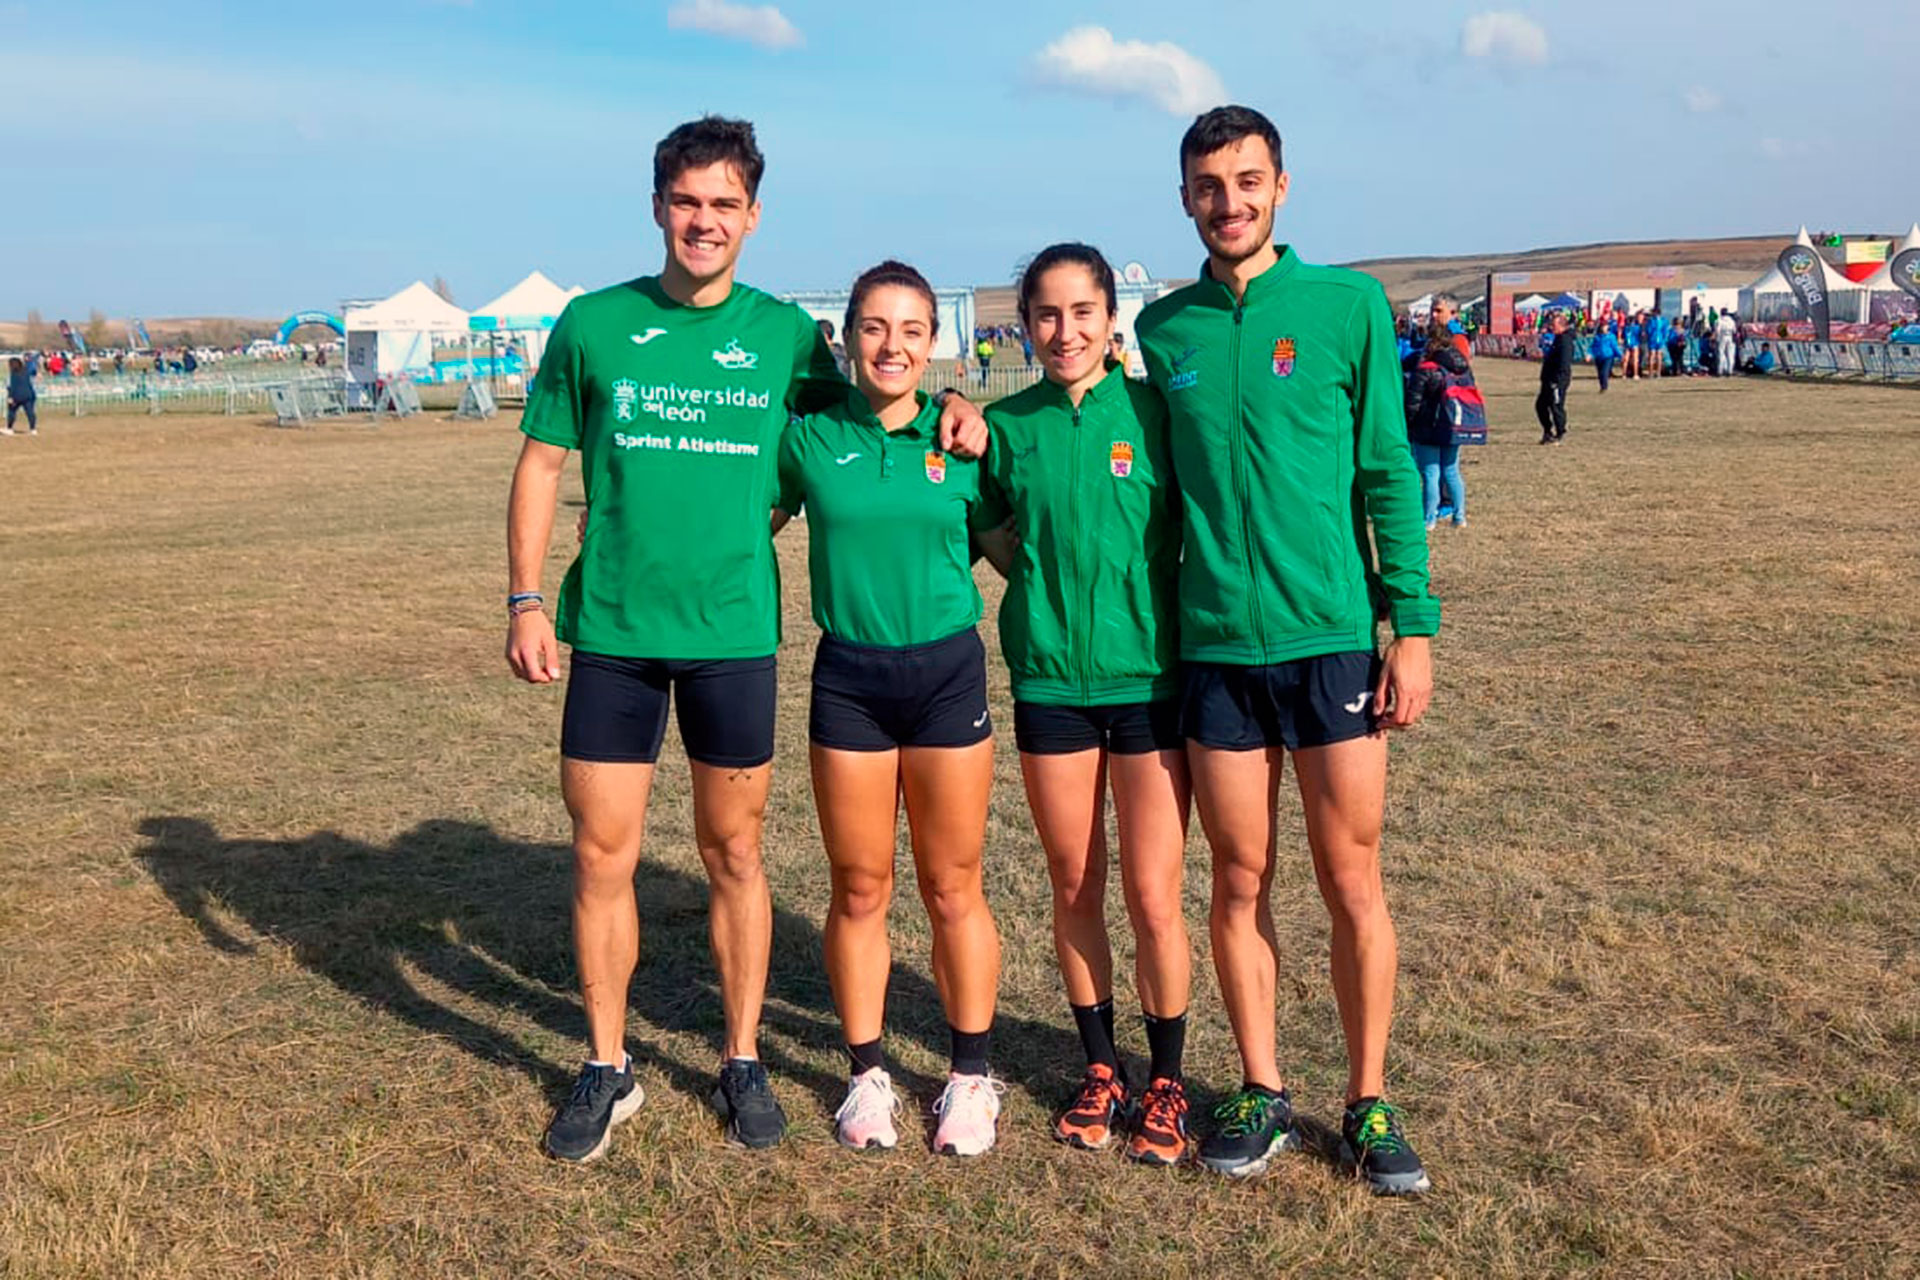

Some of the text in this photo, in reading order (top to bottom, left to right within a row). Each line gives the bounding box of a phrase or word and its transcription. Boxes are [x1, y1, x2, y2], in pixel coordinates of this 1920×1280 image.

[641, 382, 770, 408] universidad
[658, 400, 706, 423] león
[614, 432, 759, 456] Sprint Atletismo
